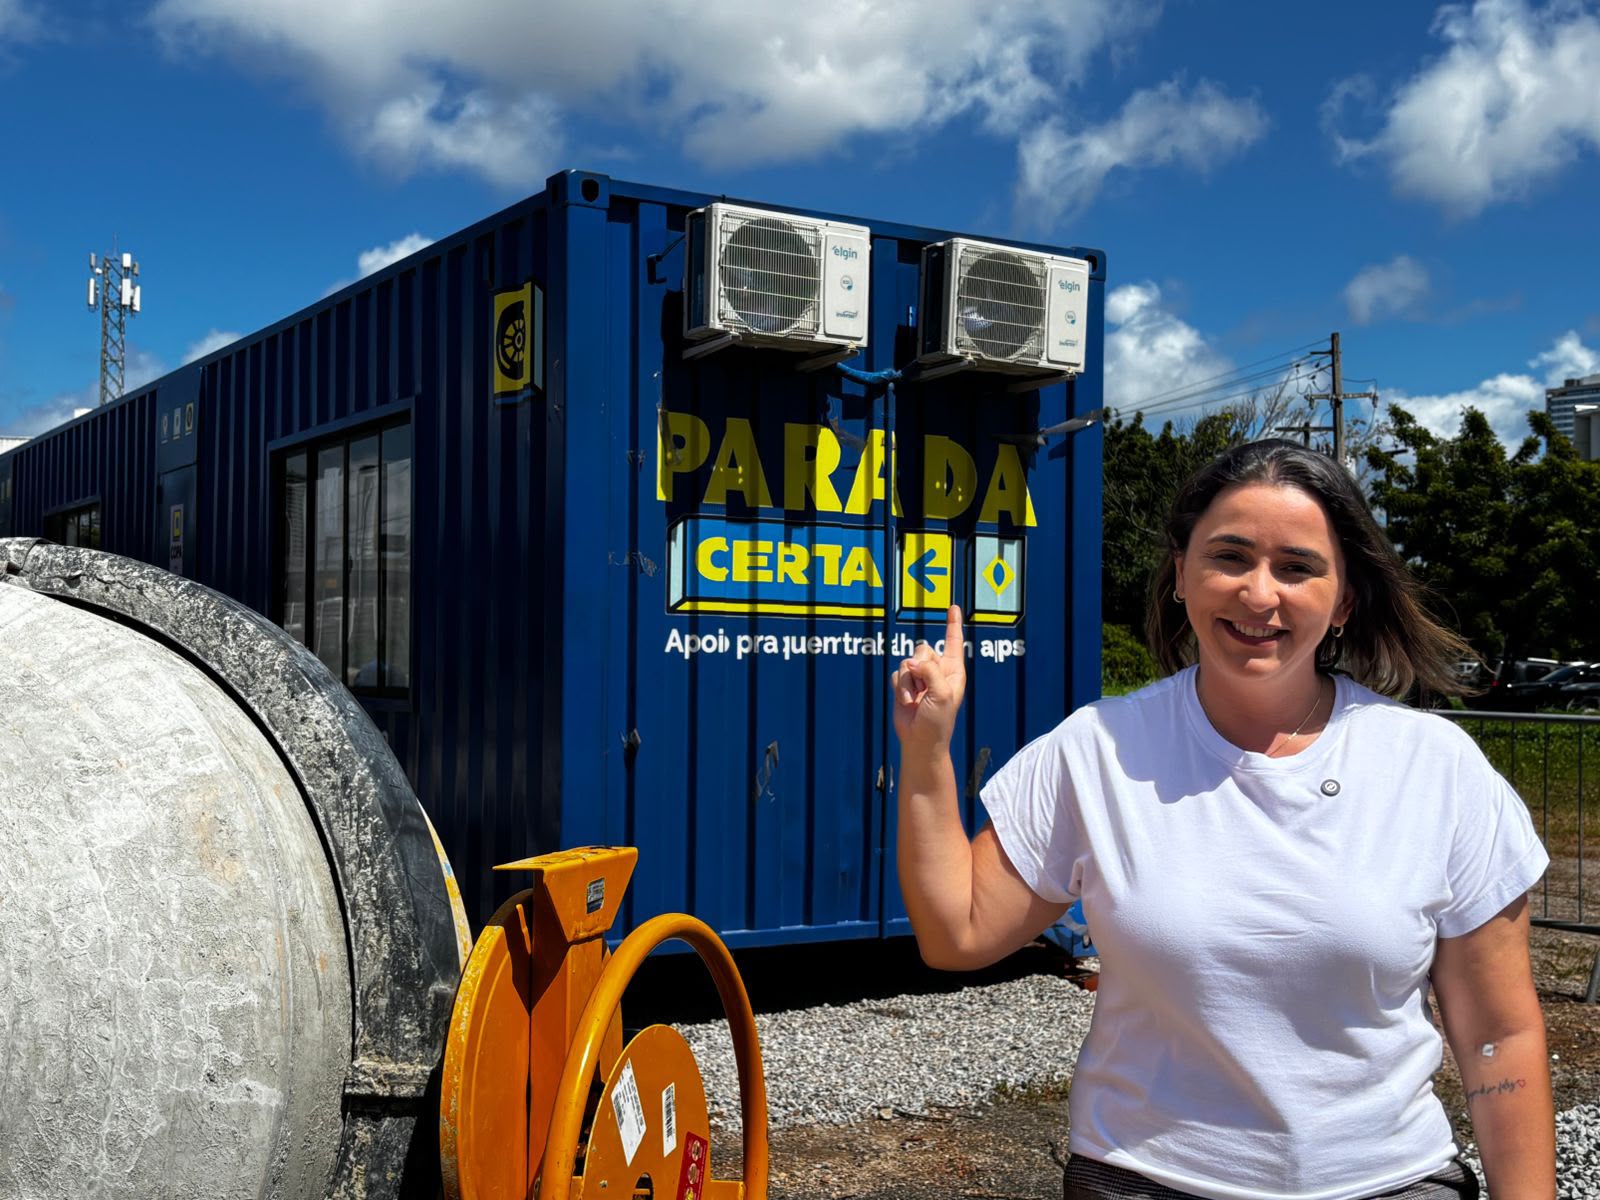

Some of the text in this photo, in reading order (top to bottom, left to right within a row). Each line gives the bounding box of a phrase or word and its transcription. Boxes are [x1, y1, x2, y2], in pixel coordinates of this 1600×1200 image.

[832, 246, 858, 260] elgin
[1058, 280, 1080, 293] elgin
[656, 411, 1038, 527] PARADA
[695, 536, 883, 588] CERTA
[736, 634, 779, 660] pra
